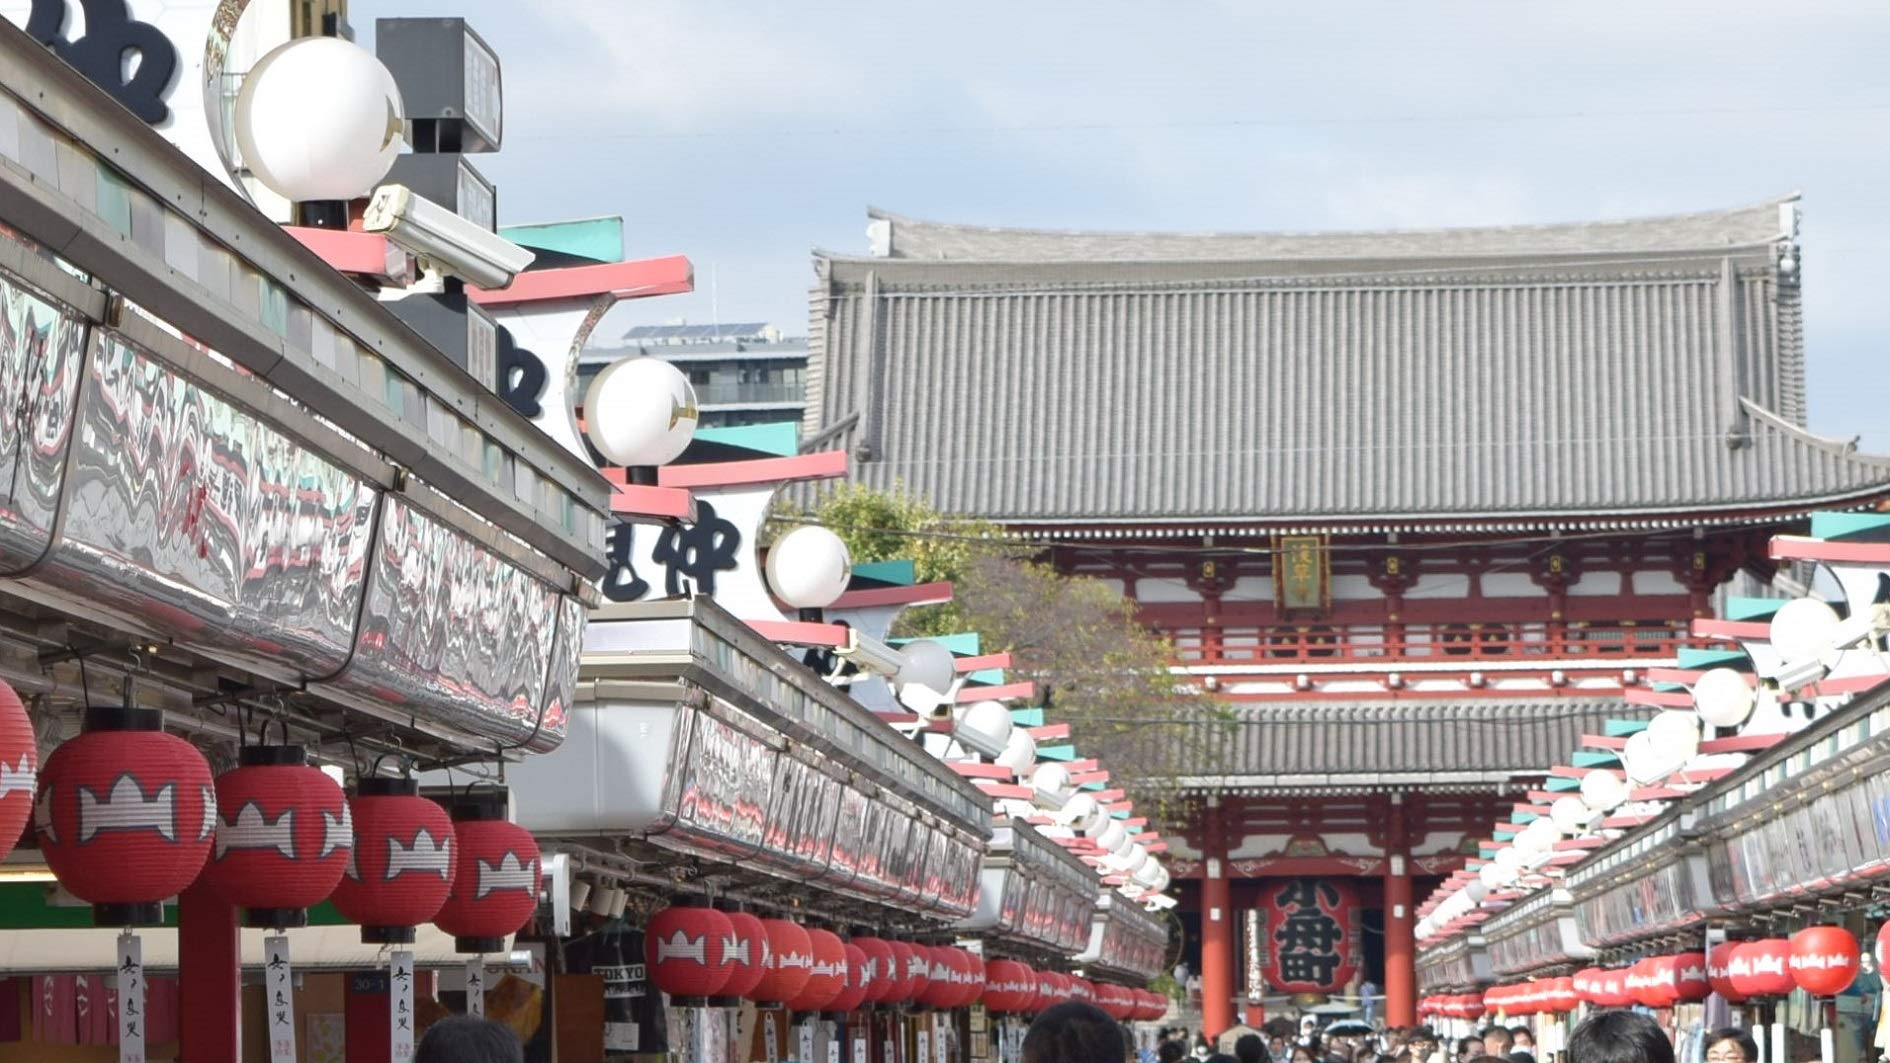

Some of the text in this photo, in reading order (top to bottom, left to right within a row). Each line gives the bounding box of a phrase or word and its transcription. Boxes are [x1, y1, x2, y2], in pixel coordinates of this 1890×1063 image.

[1275, 879, 1343, 986] 小舟町
[593, 966, 645, 980] TOKYO
